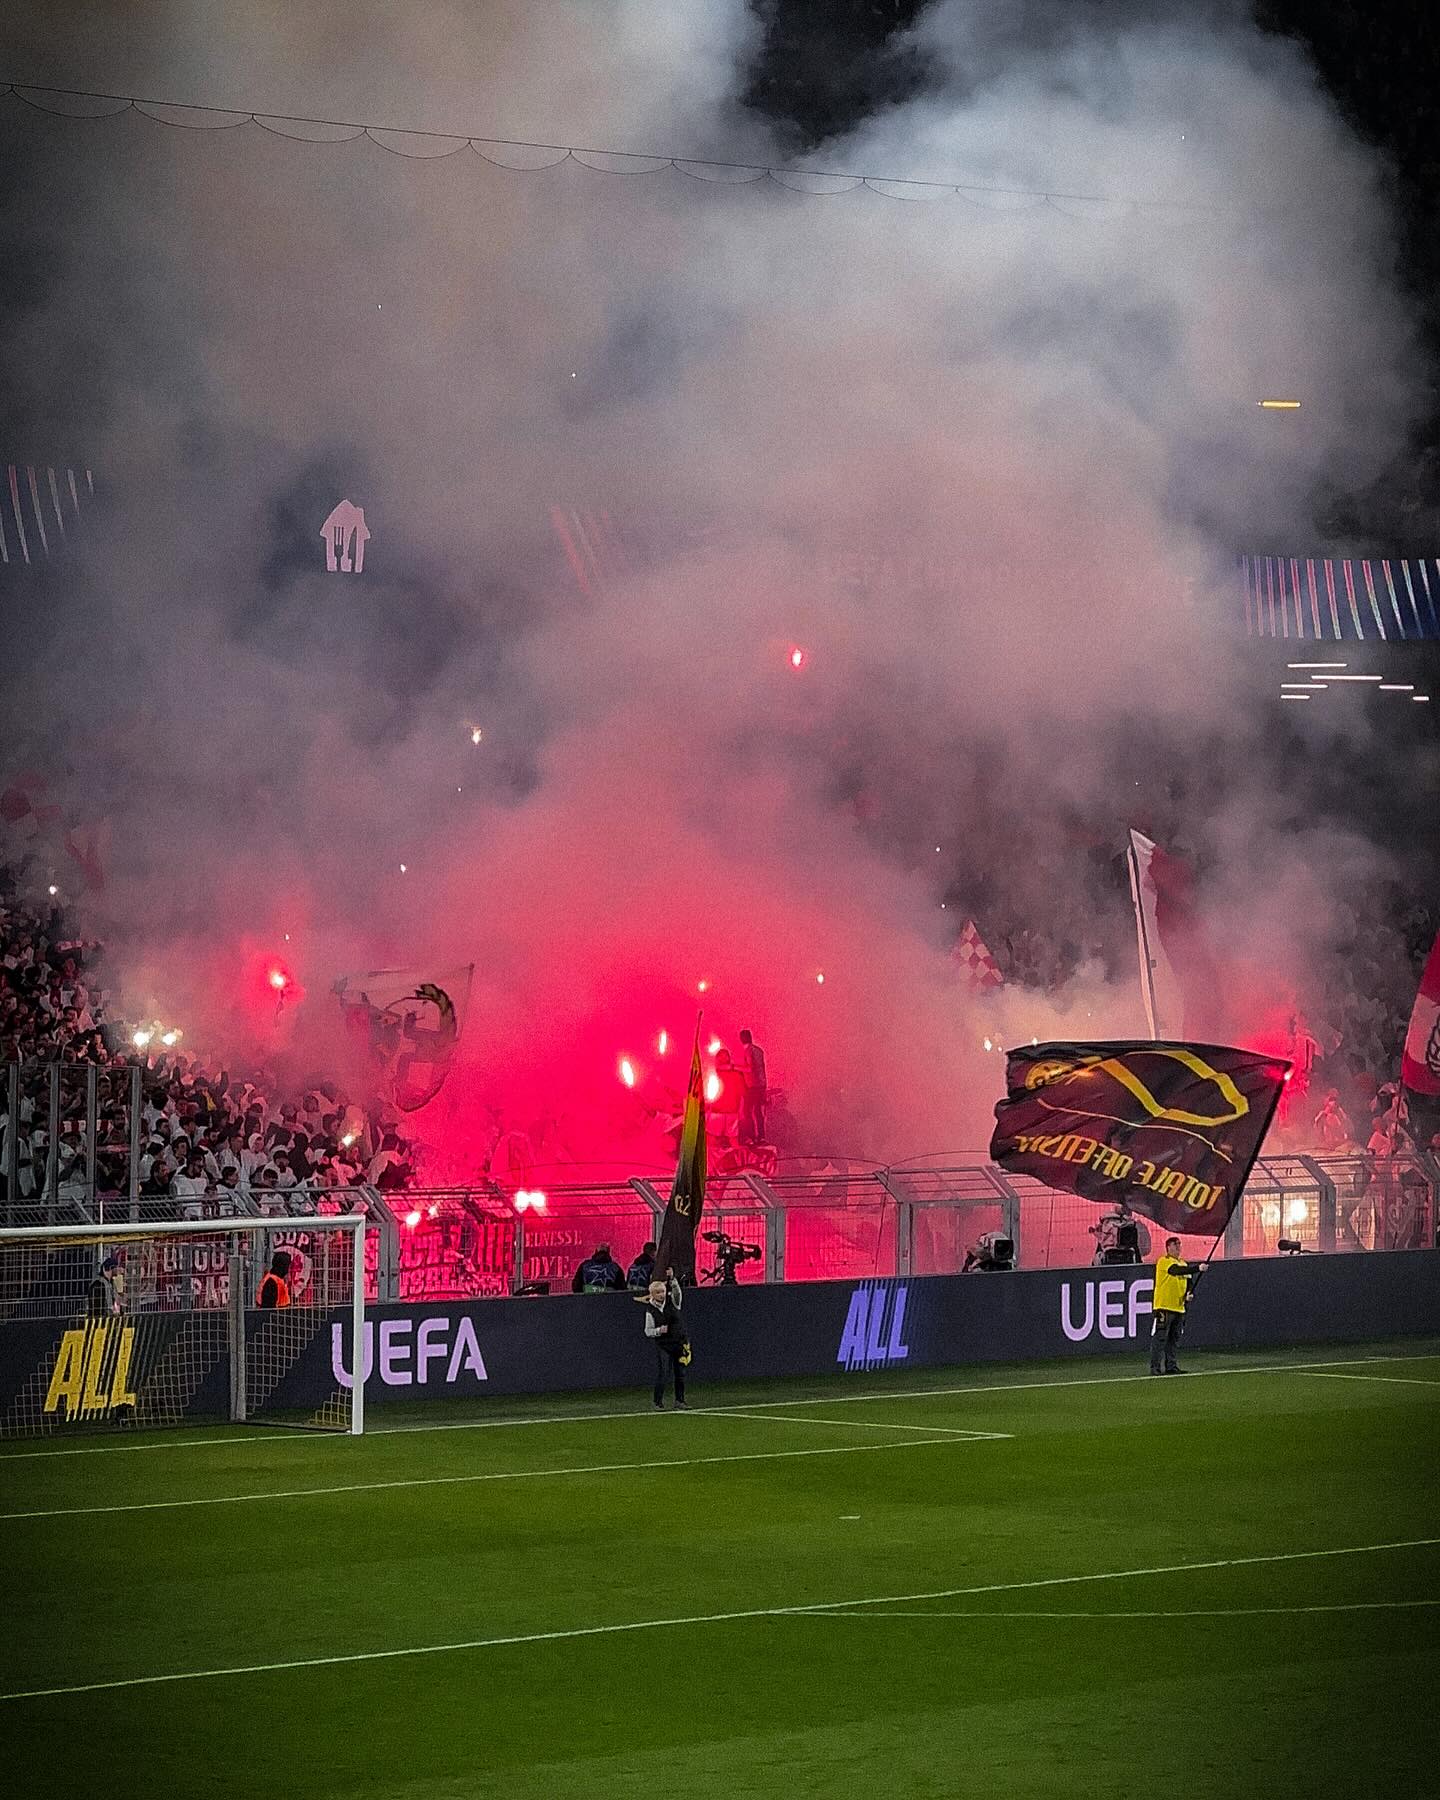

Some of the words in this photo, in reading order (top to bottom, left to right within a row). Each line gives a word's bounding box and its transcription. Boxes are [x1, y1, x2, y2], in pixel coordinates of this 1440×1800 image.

[836, 1287, 909, 1362] ALL
[1061, 1278, 1155, 1342] UEF
[44, 1327, 136, 1413] ALL
[331, 1316, 488, 1388] UEFA
